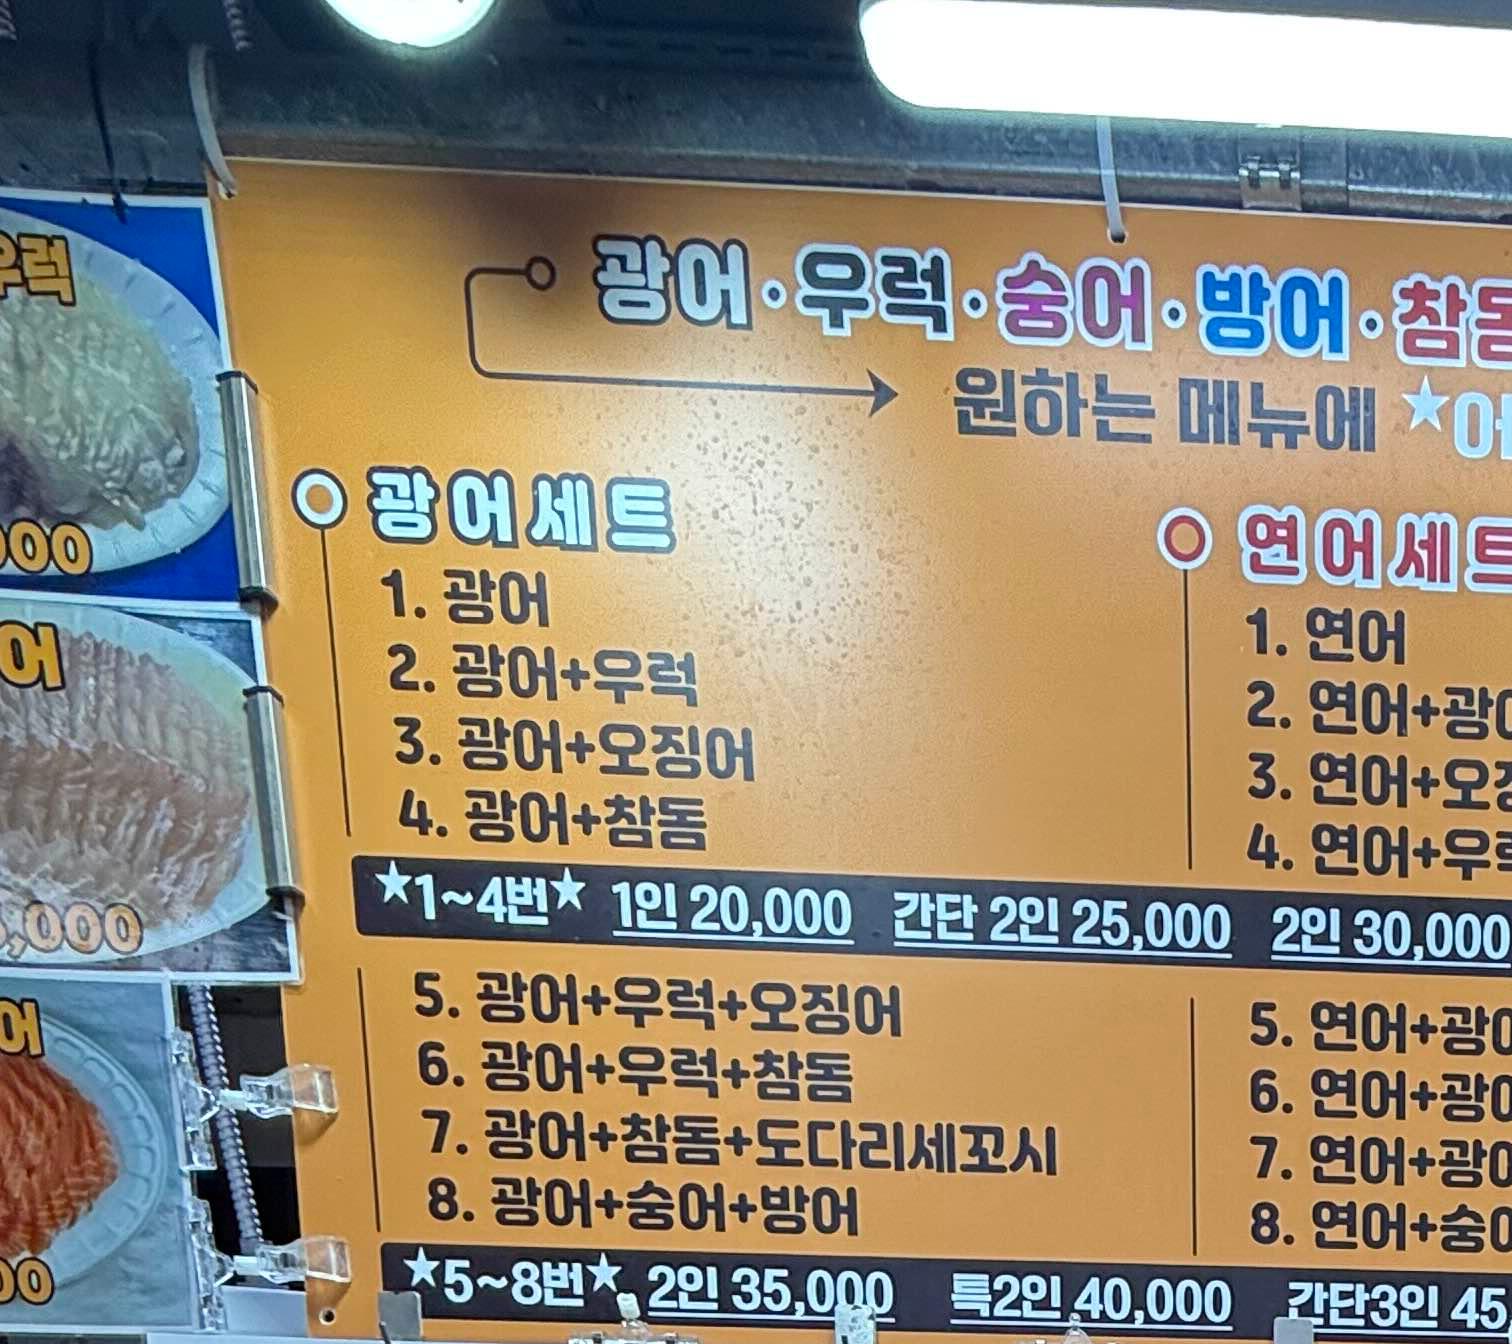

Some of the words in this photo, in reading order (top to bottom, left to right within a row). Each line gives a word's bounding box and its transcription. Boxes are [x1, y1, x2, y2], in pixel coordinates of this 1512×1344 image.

[953, 366, 1155, 446] 원하는
[1178, 374, 1377, 453] 메뉴에
[366, 465, 676, 553] 광어세트
[444, 567, 551, 628] 광어
[1305, 607, 1407, 667] 연어
[452, 641, 698, 707] 광어+우럭
[457, 715, 755, 782] 광어+오징어
[464, 790, 708, 852] 광어+참돔
[612, 880, 679, 931] 1인
[688, 886, 852, 938] 20,000
[893, 890, 978, 943] 간단
[989, 895, 1060, 946] 2인
[1071, 899, 1233, 953] 25,000
[1271, 905, 1340, 954] 2인
[1353, 910, 1512, 961] 30,000
